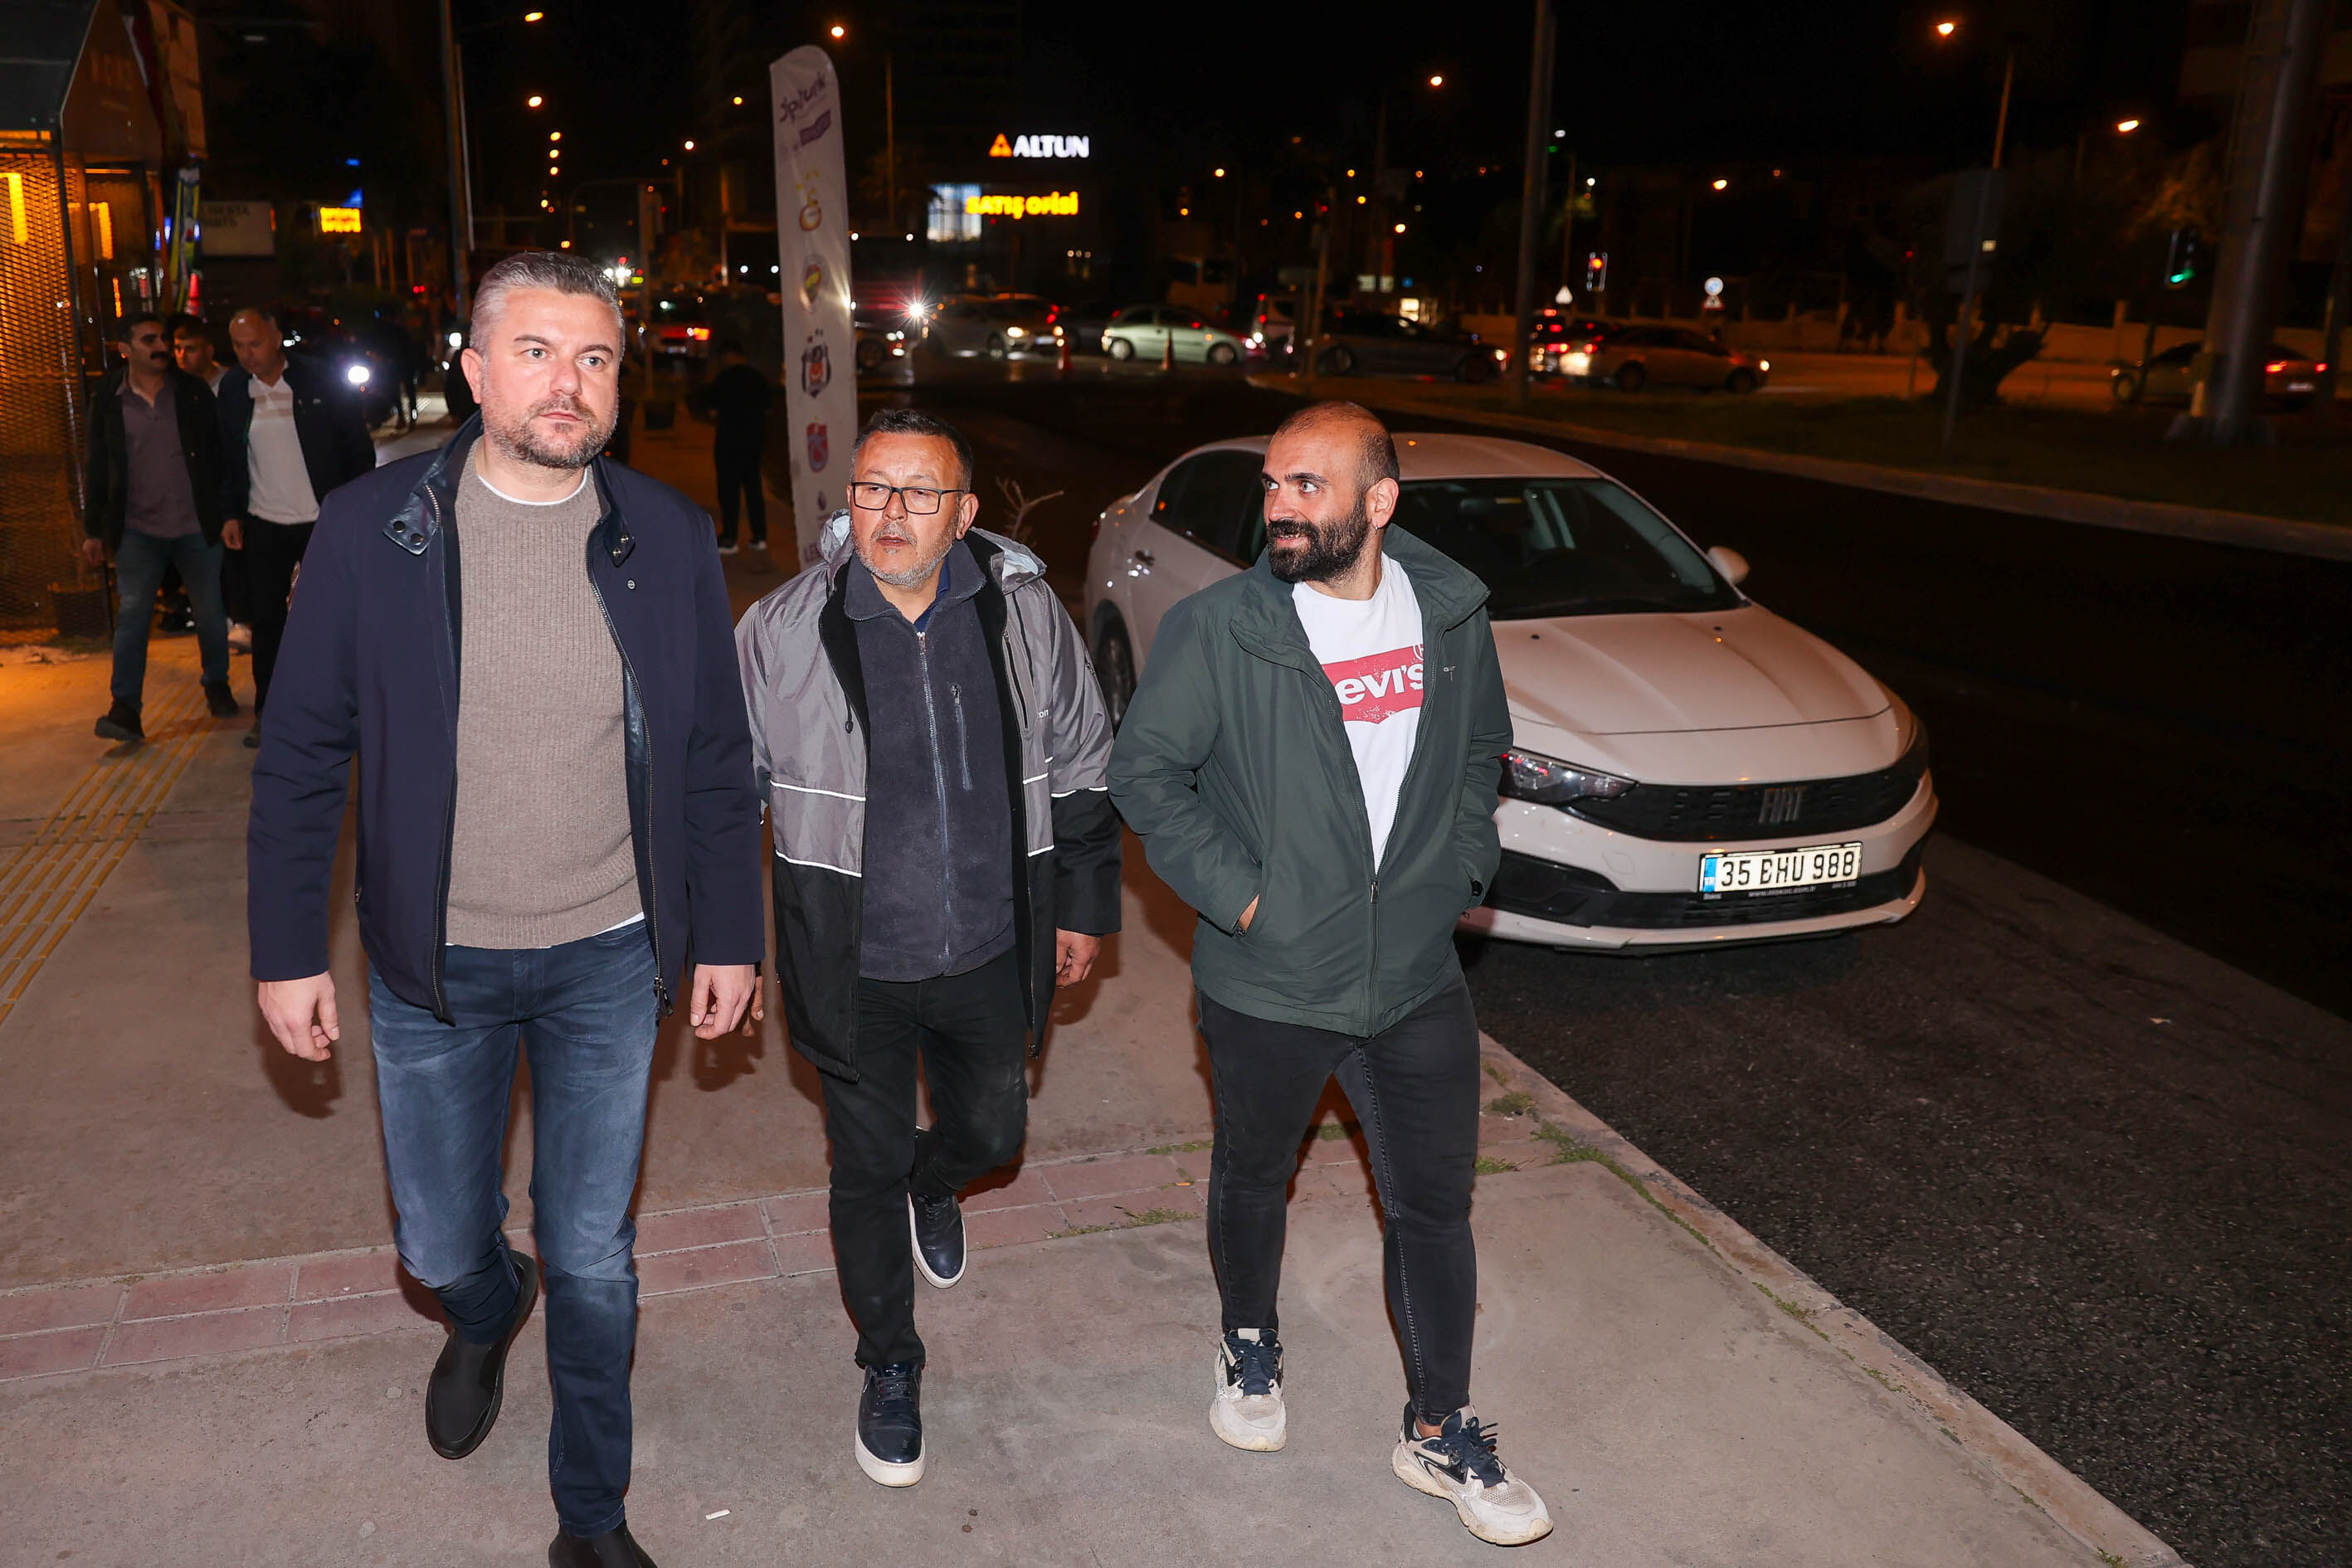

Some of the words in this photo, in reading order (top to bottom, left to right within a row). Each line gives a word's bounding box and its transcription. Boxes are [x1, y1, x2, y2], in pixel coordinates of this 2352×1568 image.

[1013, 134, 1089, 158] ALTUN
[1758, 786, 1806, 824] FIAT
[1721, 859, 1751, 887] 35
[1760, 855, 1804, 885] BHU
[1813, 850, 1855, 880] 988
